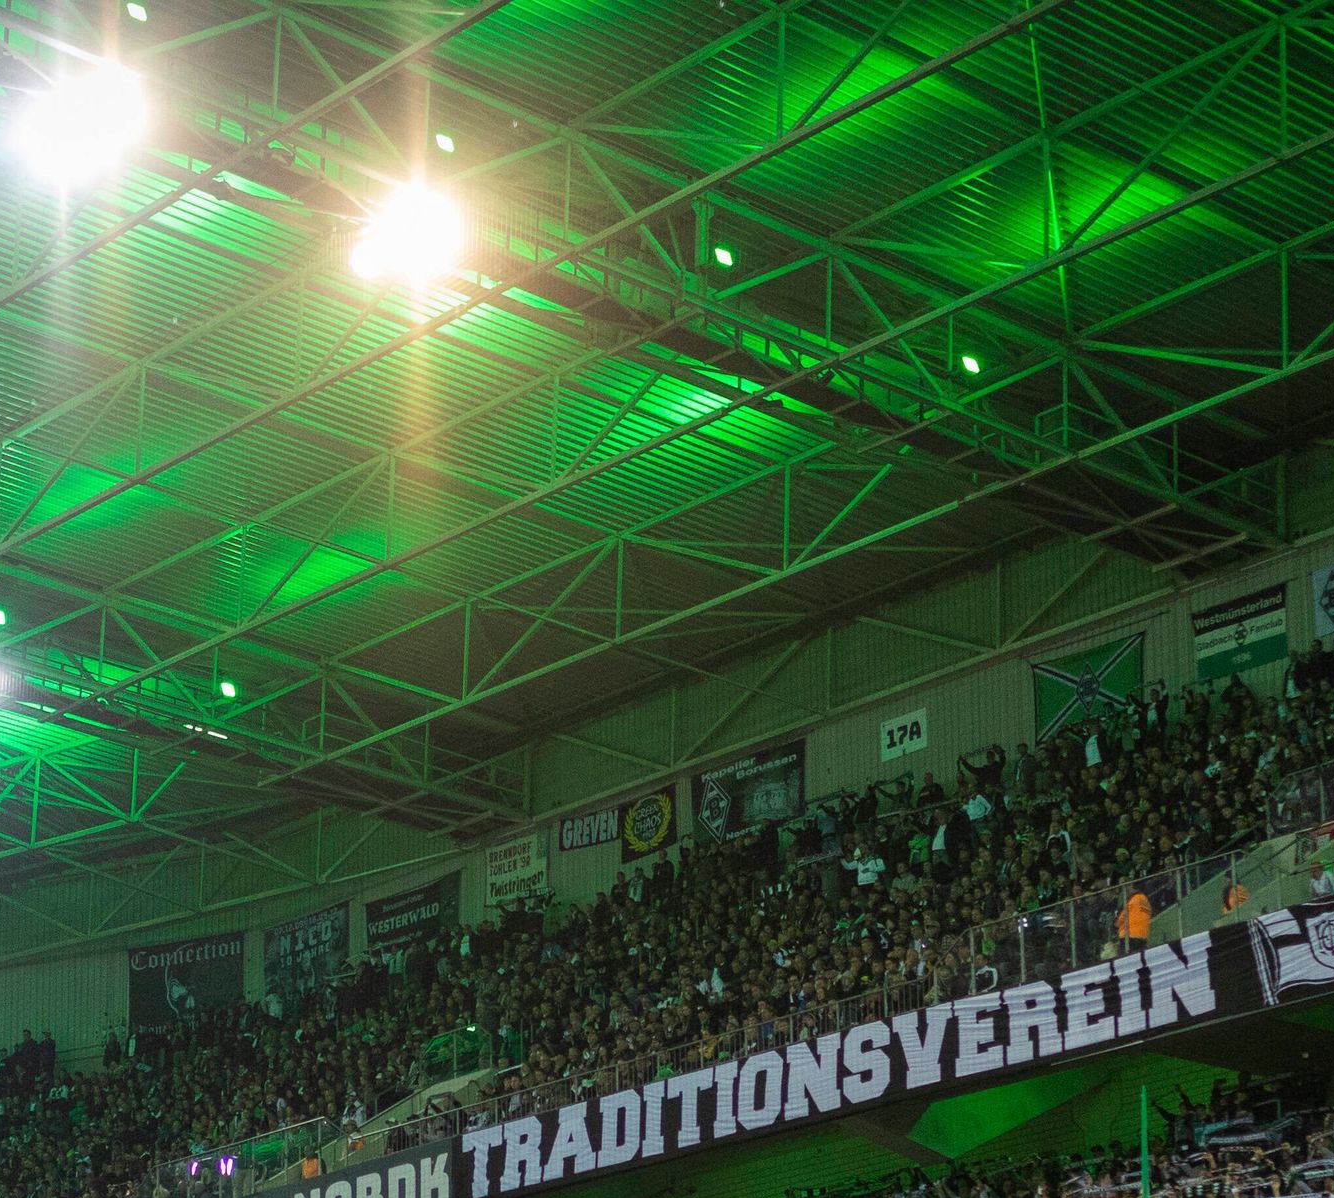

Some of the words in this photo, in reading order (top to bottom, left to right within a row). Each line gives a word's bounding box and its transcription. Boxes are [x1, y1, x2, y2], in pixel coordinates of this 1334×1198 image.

[886, 721, 923, 748] 17A
[735, 753, 798, 781] Borussen
[562, 810, 619, 849] GREVEN
[367, 902, 440, 938] WESTERWALD
[279, 920, 333, 953] NICO
[130, 941, 242, 971] Connection
